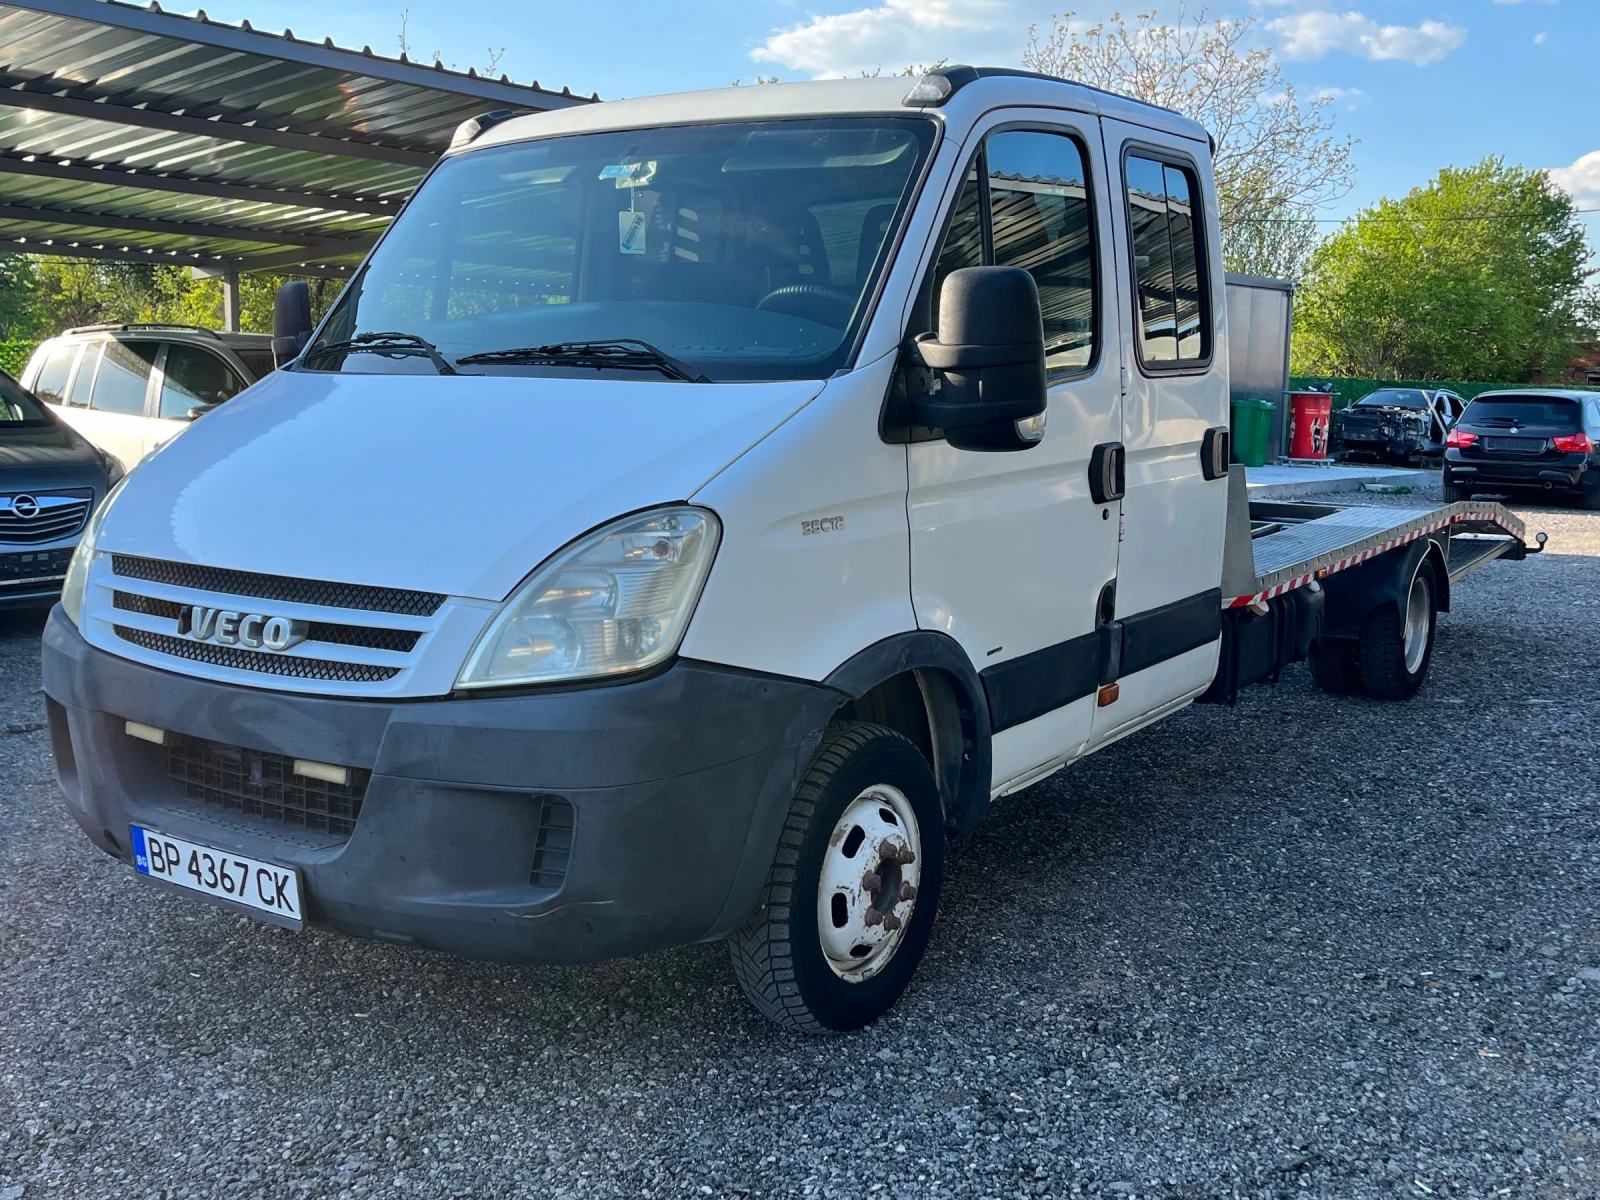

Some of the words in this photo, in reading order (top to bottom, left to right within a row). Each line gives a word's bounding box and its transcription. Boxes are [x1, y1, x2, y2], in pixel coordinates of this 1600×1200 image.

[625, 217, 644, 245] mobile.bg
[177, 605, 294, 651] IVECO
[136, 854, 148, 868] BG
[148, 836, 181, 877] BP
[187, 849, 249, 897] 4367
[256, 867, 295, 913] CK
